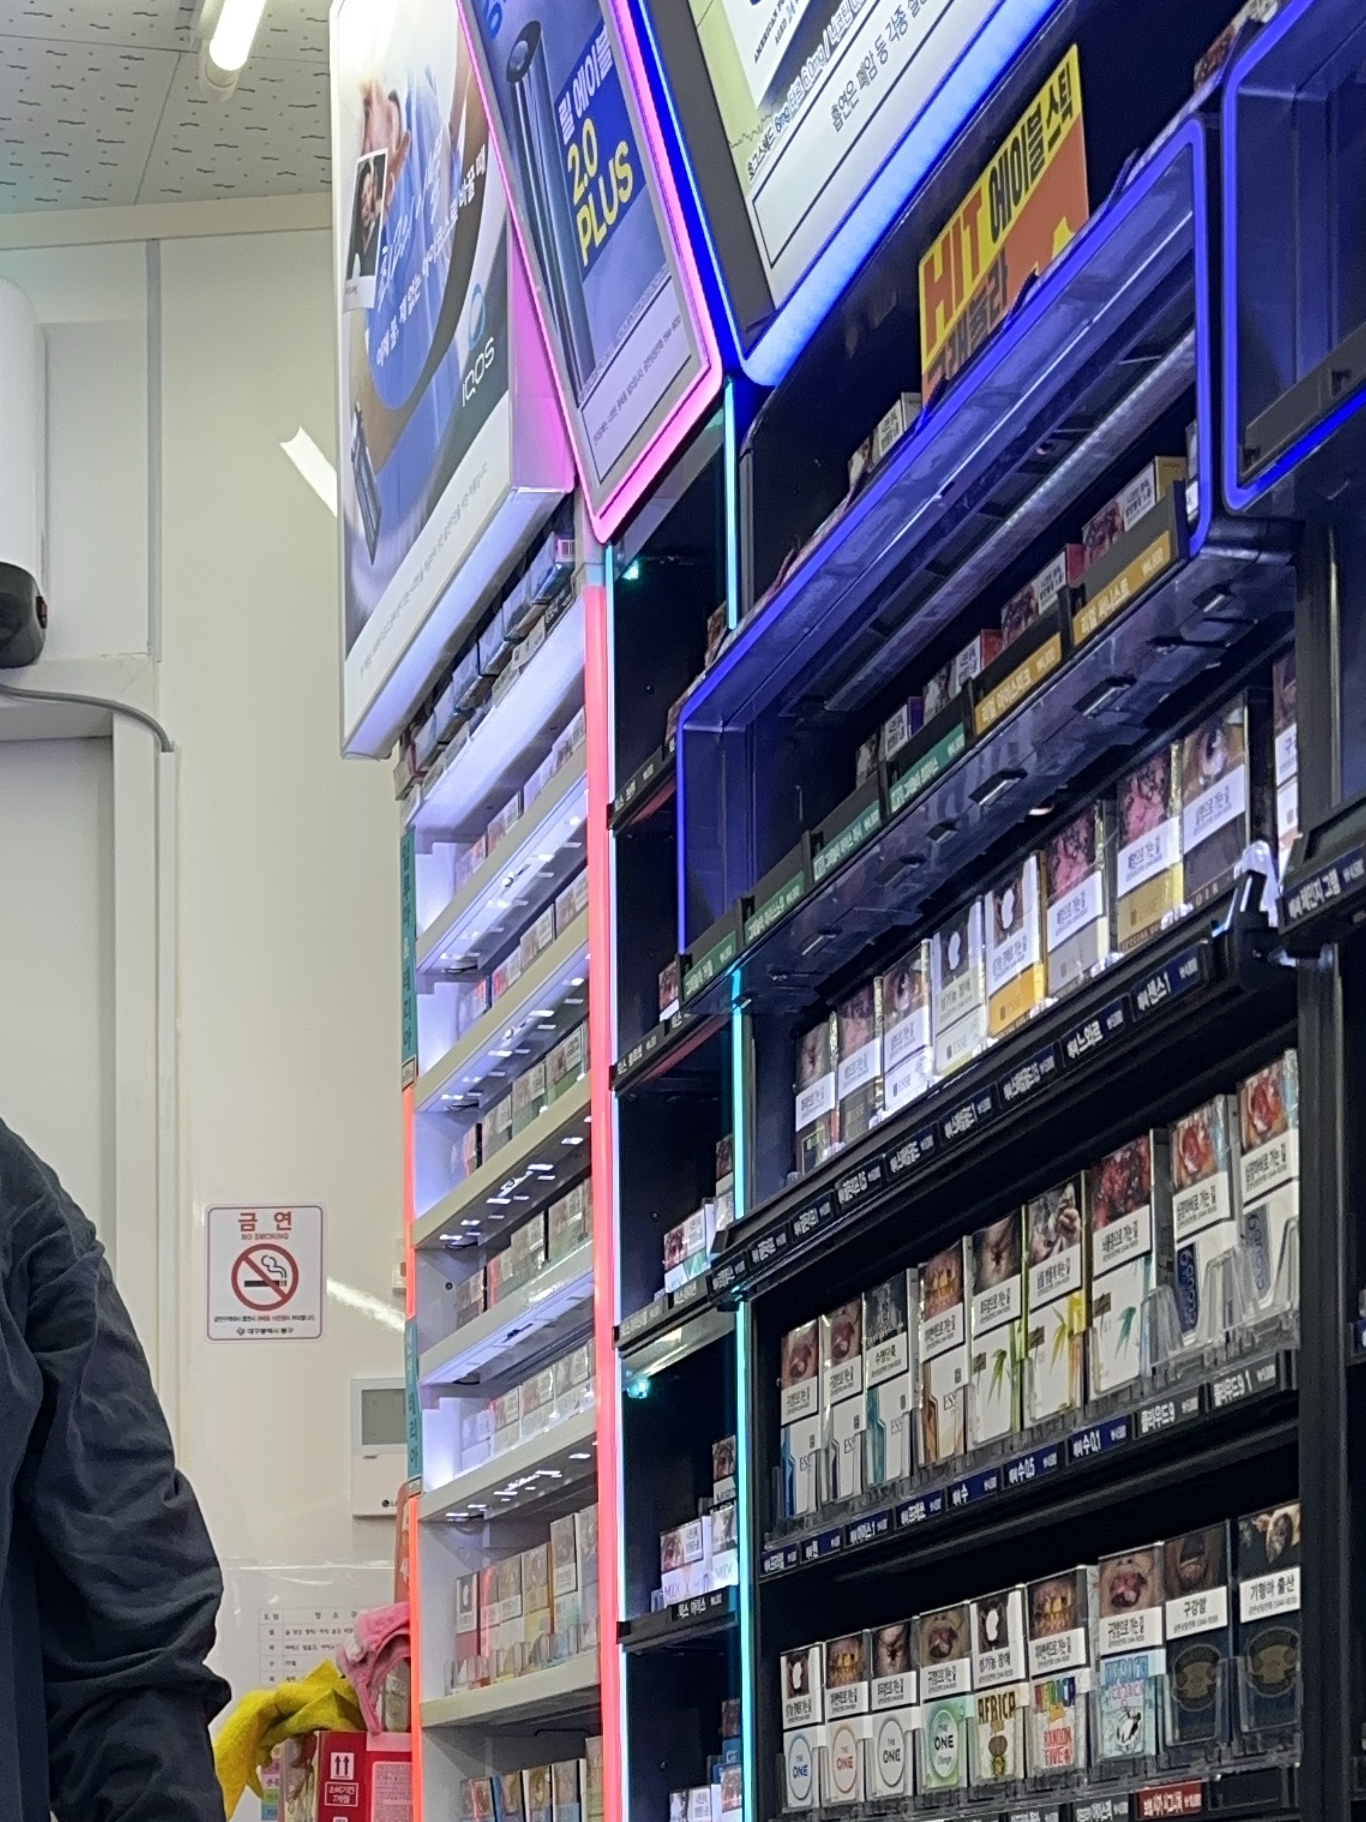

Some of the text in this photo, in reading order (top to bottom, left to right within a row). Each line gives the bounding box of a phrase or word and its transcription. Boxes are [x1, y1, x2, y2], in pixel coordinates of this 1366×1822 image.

[573, 25, 614, 118] 에이블
[830, 80, 860, 132] 흡연은
[855, 51, 879, 90] 폐암
[568, 118, 598, 205] 2.0
[576, 141, 634, 267] PLUS
[923, 185, 983, 361] HIT
[461, 336, 495, 408] IQOS
[241, 1232, 290, 1241] NO SMOKING
[1250, 1572, 1294, 1601] 기형아 출산
[1184, 1596, 1207, 1618] 구강암
[977, 1691, 1017, 1725] AFRICA
[883, 1748, 901, 1764] ONE
[934, 1734, 955, 1750] ONE
[792, 1763, 809, 1779] ONE
[836, 1756, 854, 1771] ONE
